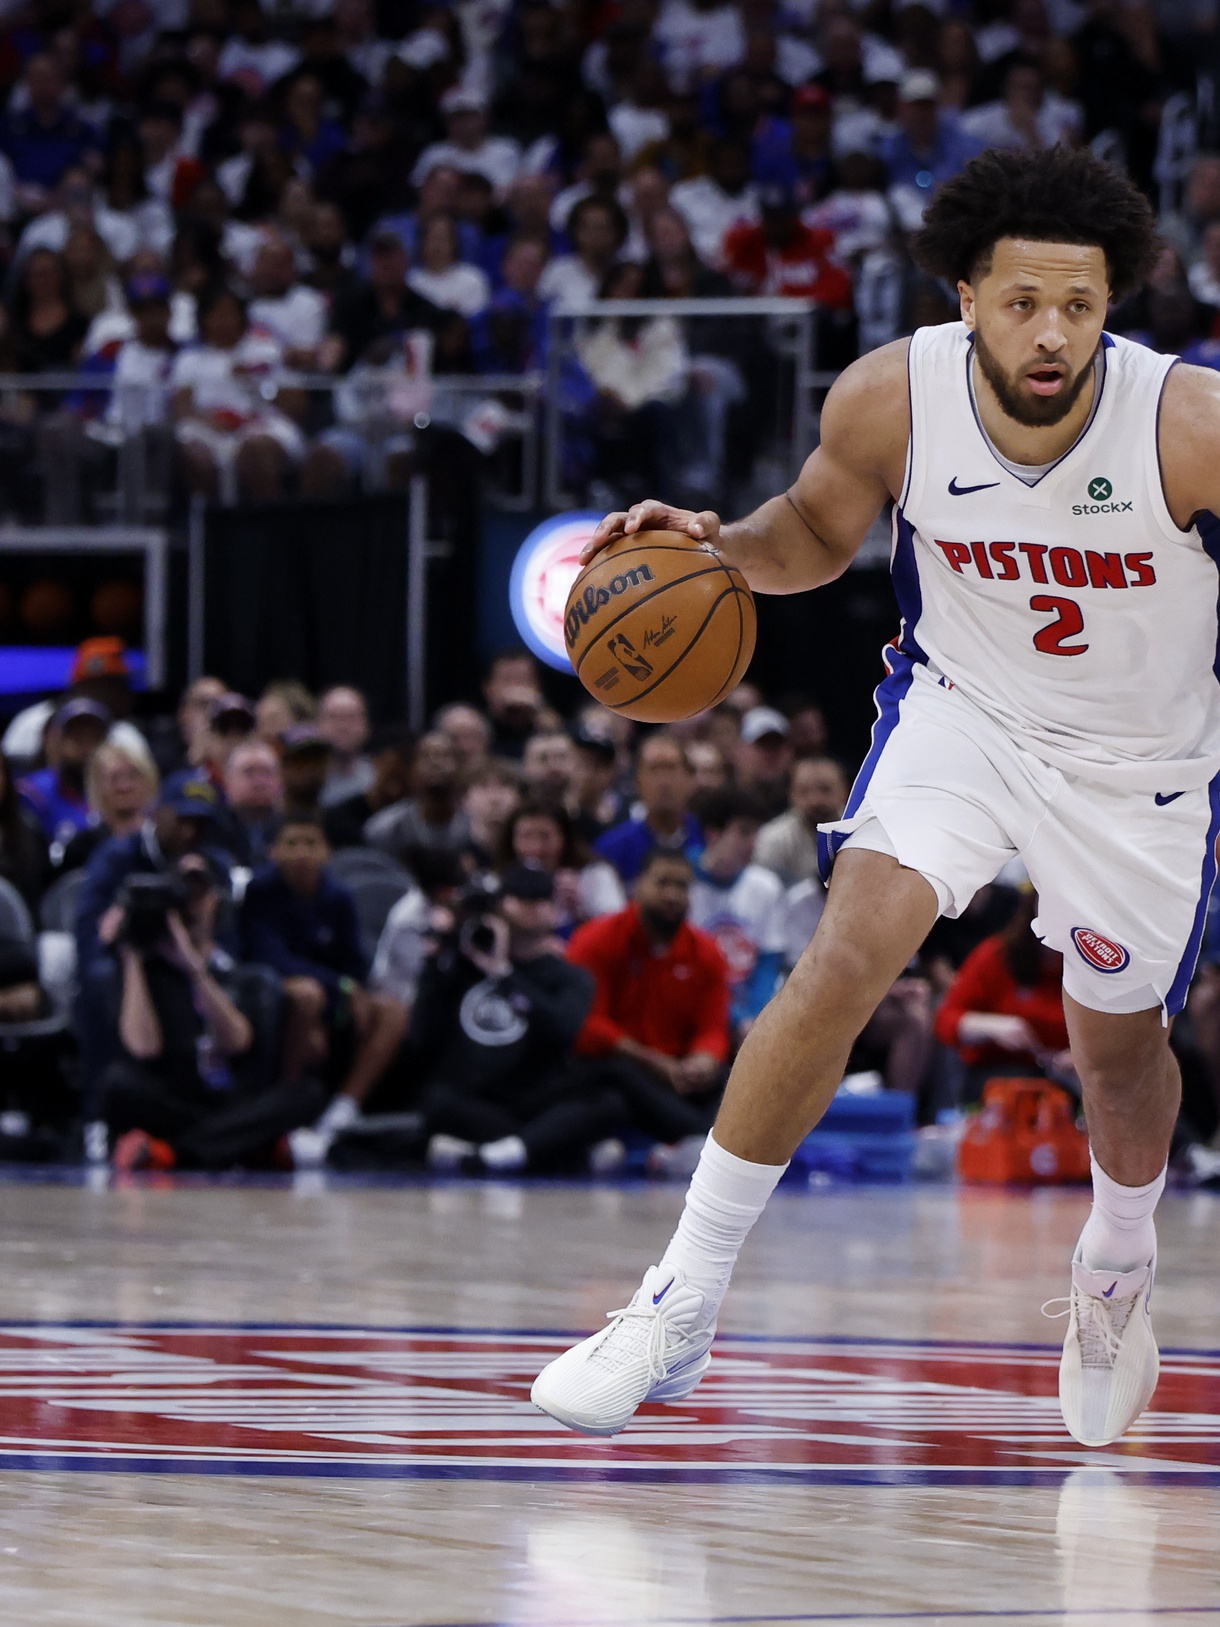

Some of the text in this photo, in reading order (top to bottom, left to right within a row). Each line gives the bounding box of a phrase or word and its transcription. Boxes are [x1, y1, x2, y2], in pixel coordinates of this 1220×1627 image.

[934, 539, 1157, 589] PISTONS
[1029, 594, 1090, 657] 2
[1081, 936, 1114, 964] PISTONS
[1086, 933, 1119, 959] DETROIT
